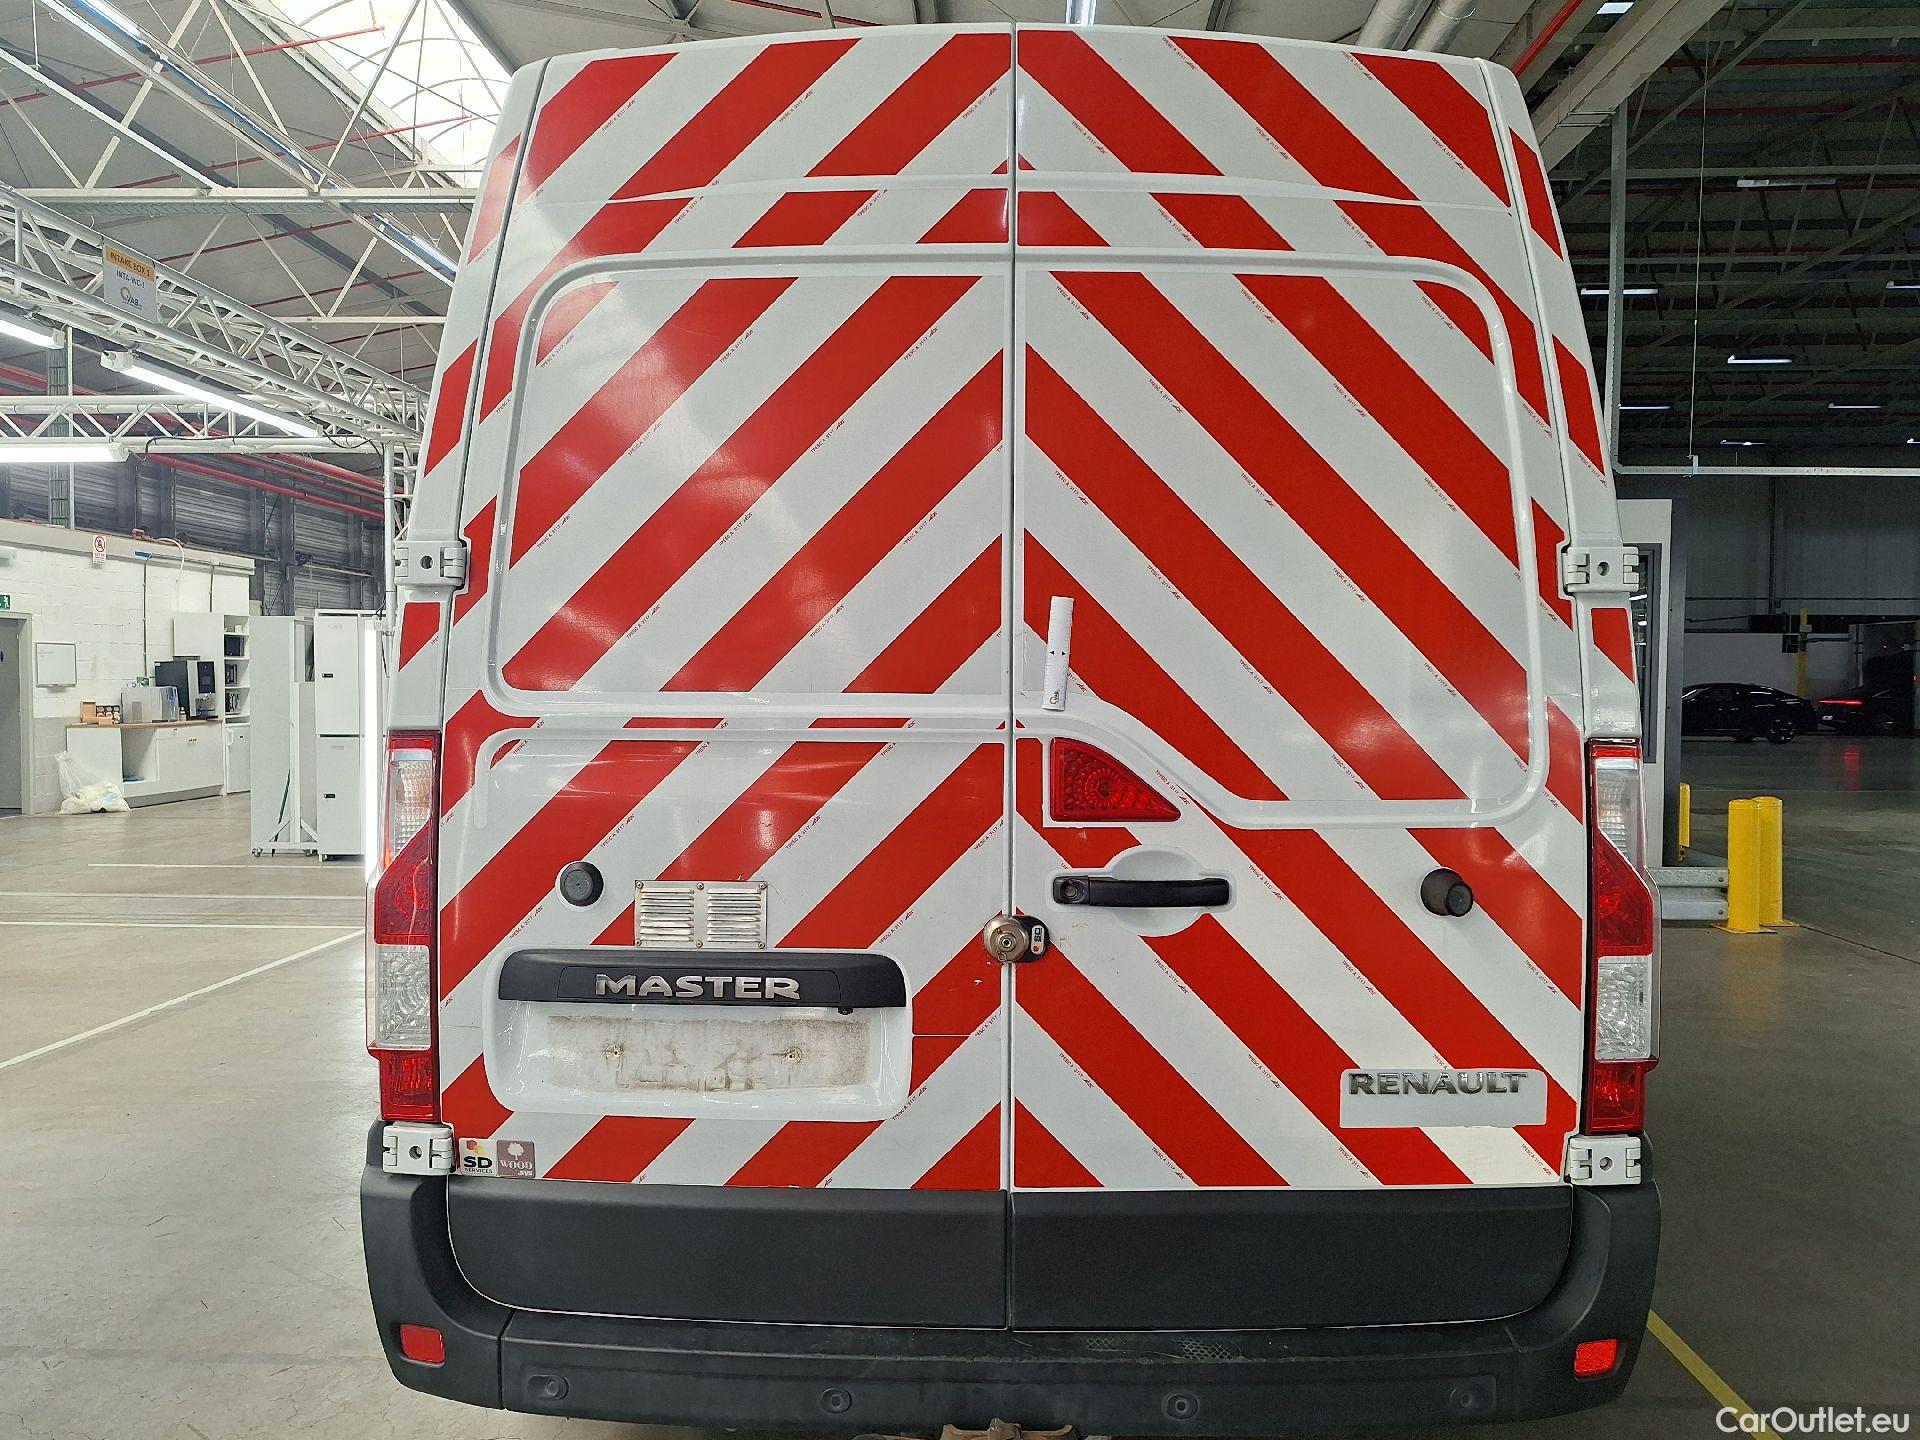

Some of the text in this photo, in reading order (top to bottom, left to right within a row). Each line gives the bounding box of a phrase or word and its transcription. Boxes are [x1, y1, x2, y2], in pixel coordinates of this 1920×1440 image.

[110, 252, 133, 268] INTAKE
[595, 974, 800, 1000] MASTER
[1348, 1072, 1528, 1095] RENAULT
[464, 1156, 492, 1168] SD
[500, 1161, 533, 1170] WOOD
